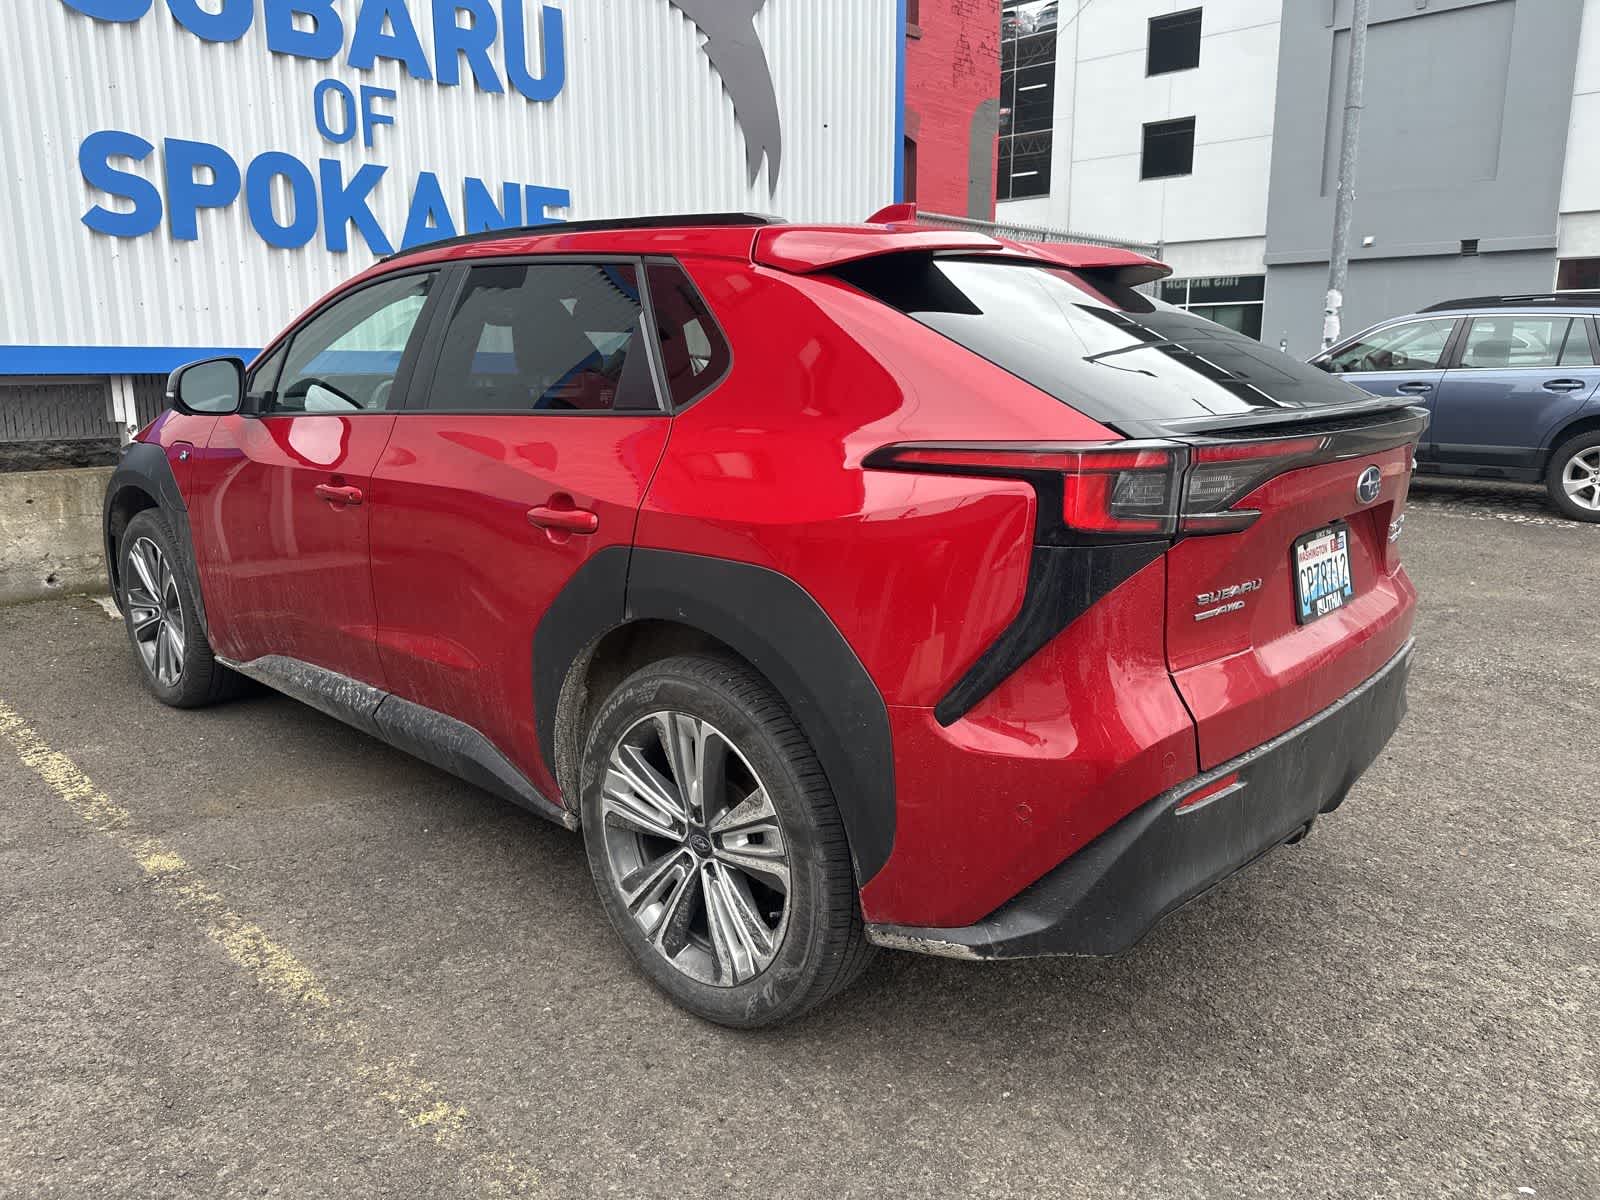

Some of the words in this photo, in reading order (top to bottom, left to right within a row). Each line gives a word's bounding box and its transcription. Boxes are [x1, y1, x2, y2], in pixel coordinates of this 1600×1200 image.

[60, 0, 565, 101] BARU
[314, 79, 397, 147] OF
[1299, 545, 1328, 561] WASHINGTON
[1197, 578, 1262, 605] SUBARU
